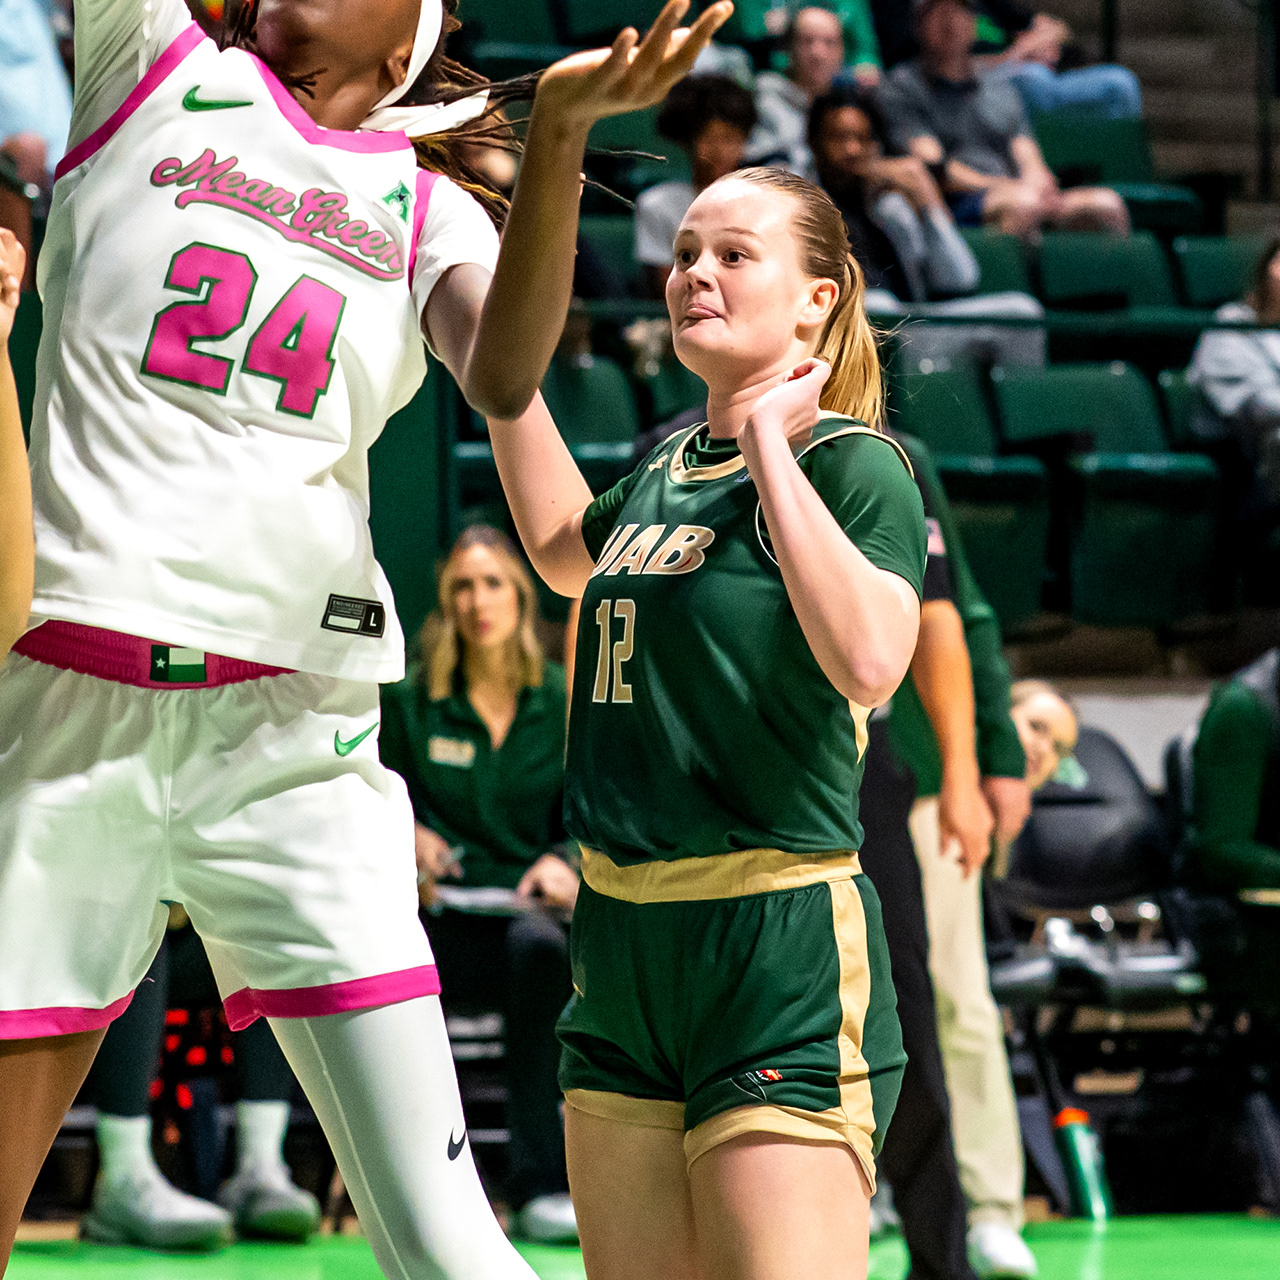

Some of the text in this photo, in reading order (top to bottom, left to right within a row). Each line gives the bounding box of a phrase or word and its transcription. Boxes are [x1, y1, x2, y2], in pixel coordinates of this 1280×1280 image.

[150, 148, 405, 271] Mean Green
[140, 241, 347, 420] 24
[589, 523, 715, 580] UAB
[369, 612, 377, 627] L
[591, 598, 636, 704] 12
